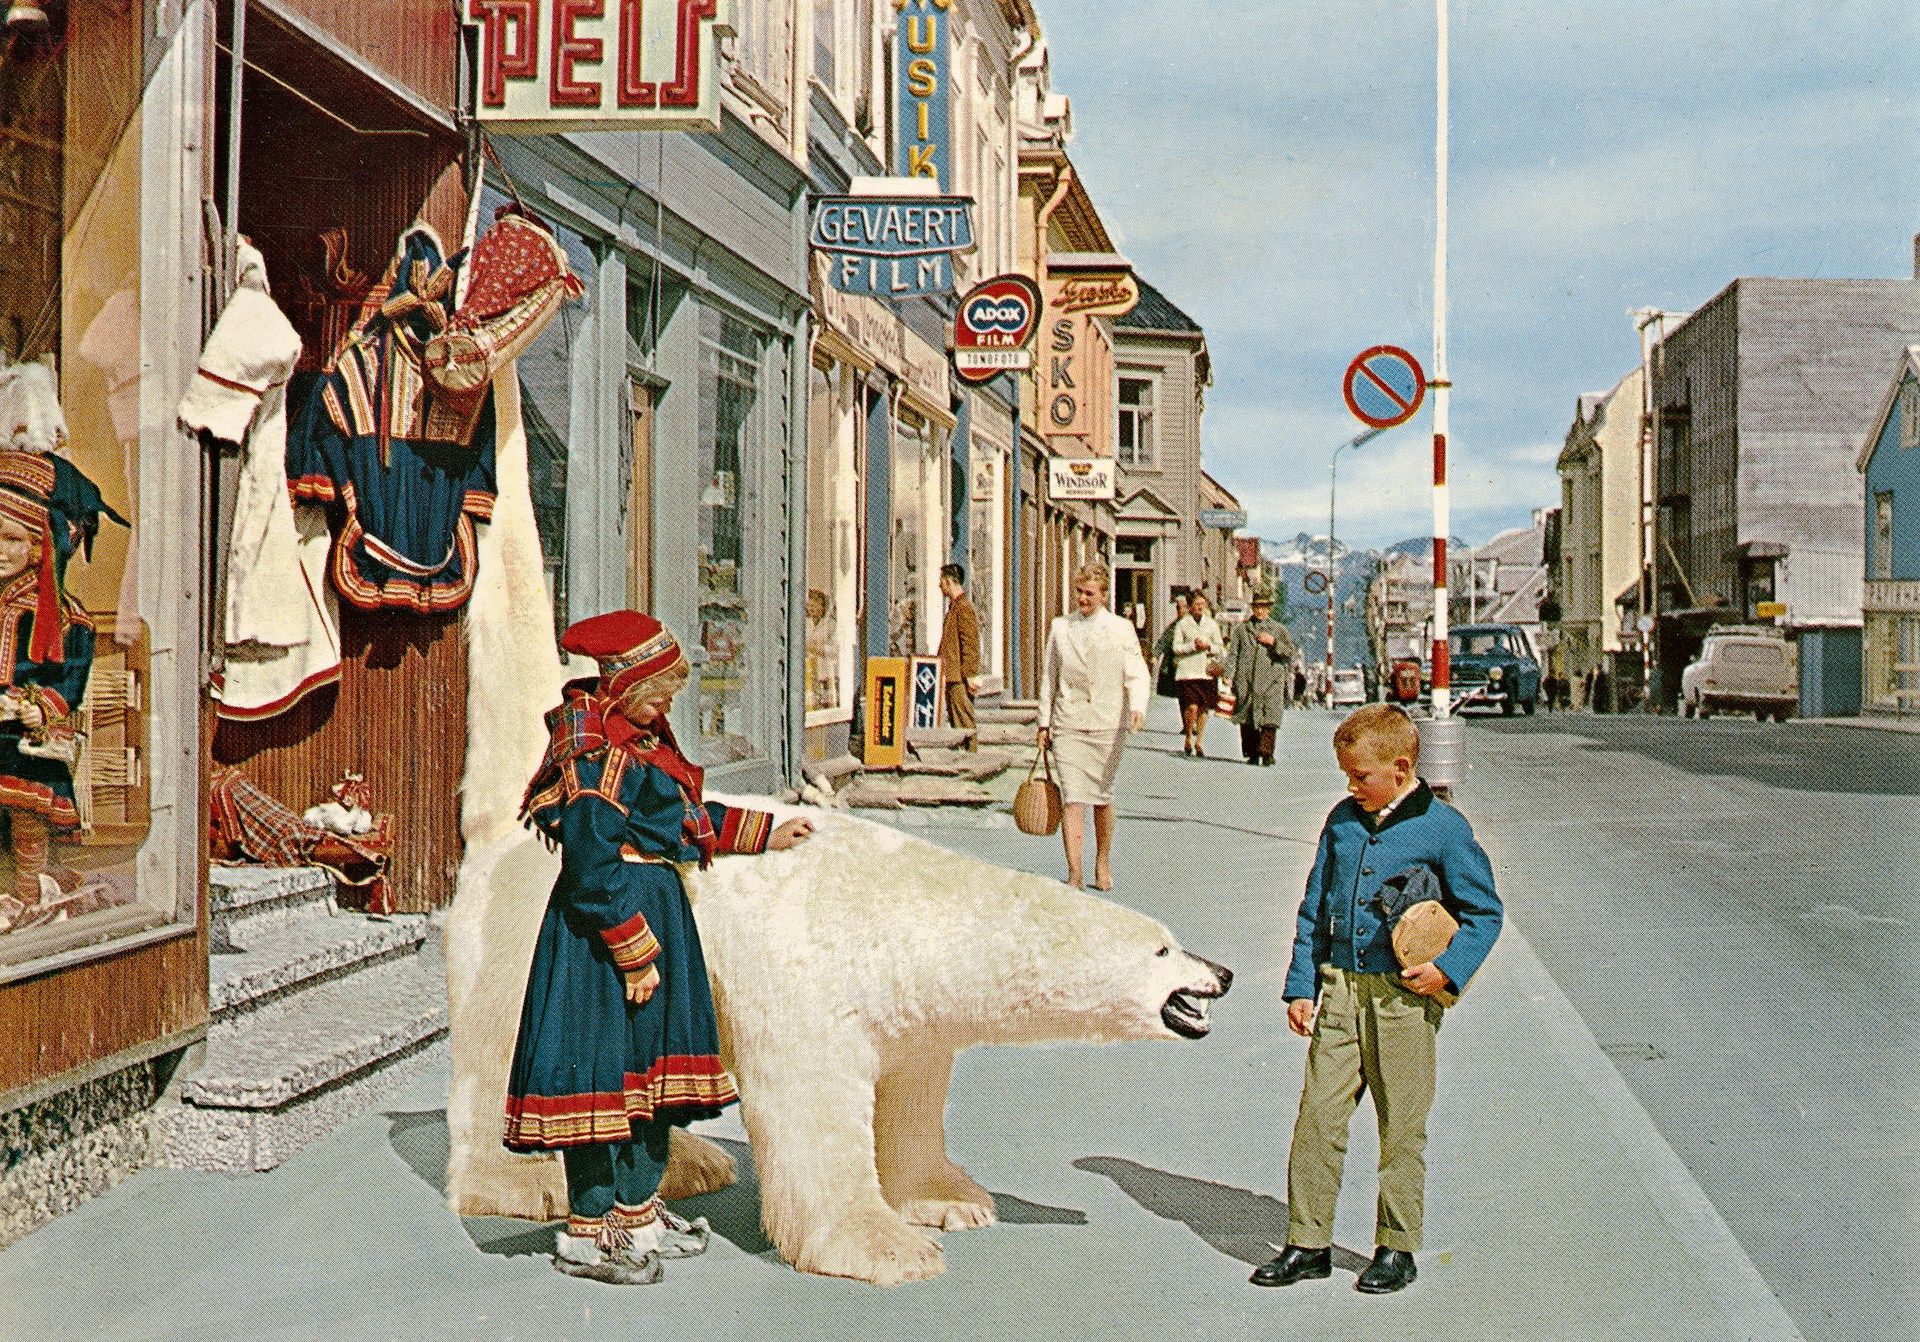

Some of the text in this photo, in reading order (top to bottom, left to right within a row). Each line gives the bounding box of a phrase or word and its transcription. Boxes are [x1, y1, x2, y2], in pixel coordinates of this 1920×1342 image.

[897, 0, 948, 178] USIK
[819, 206, 963, 243] GEVAERT
[841, 252, 943, 292] FILM
[972, 306, 1022, 322] ADOX
[976, 333, 1016, 347] FILM
[1050, 318, 1076, 427] SKO
[1053, 471, 1108, 489] WINDSOR
